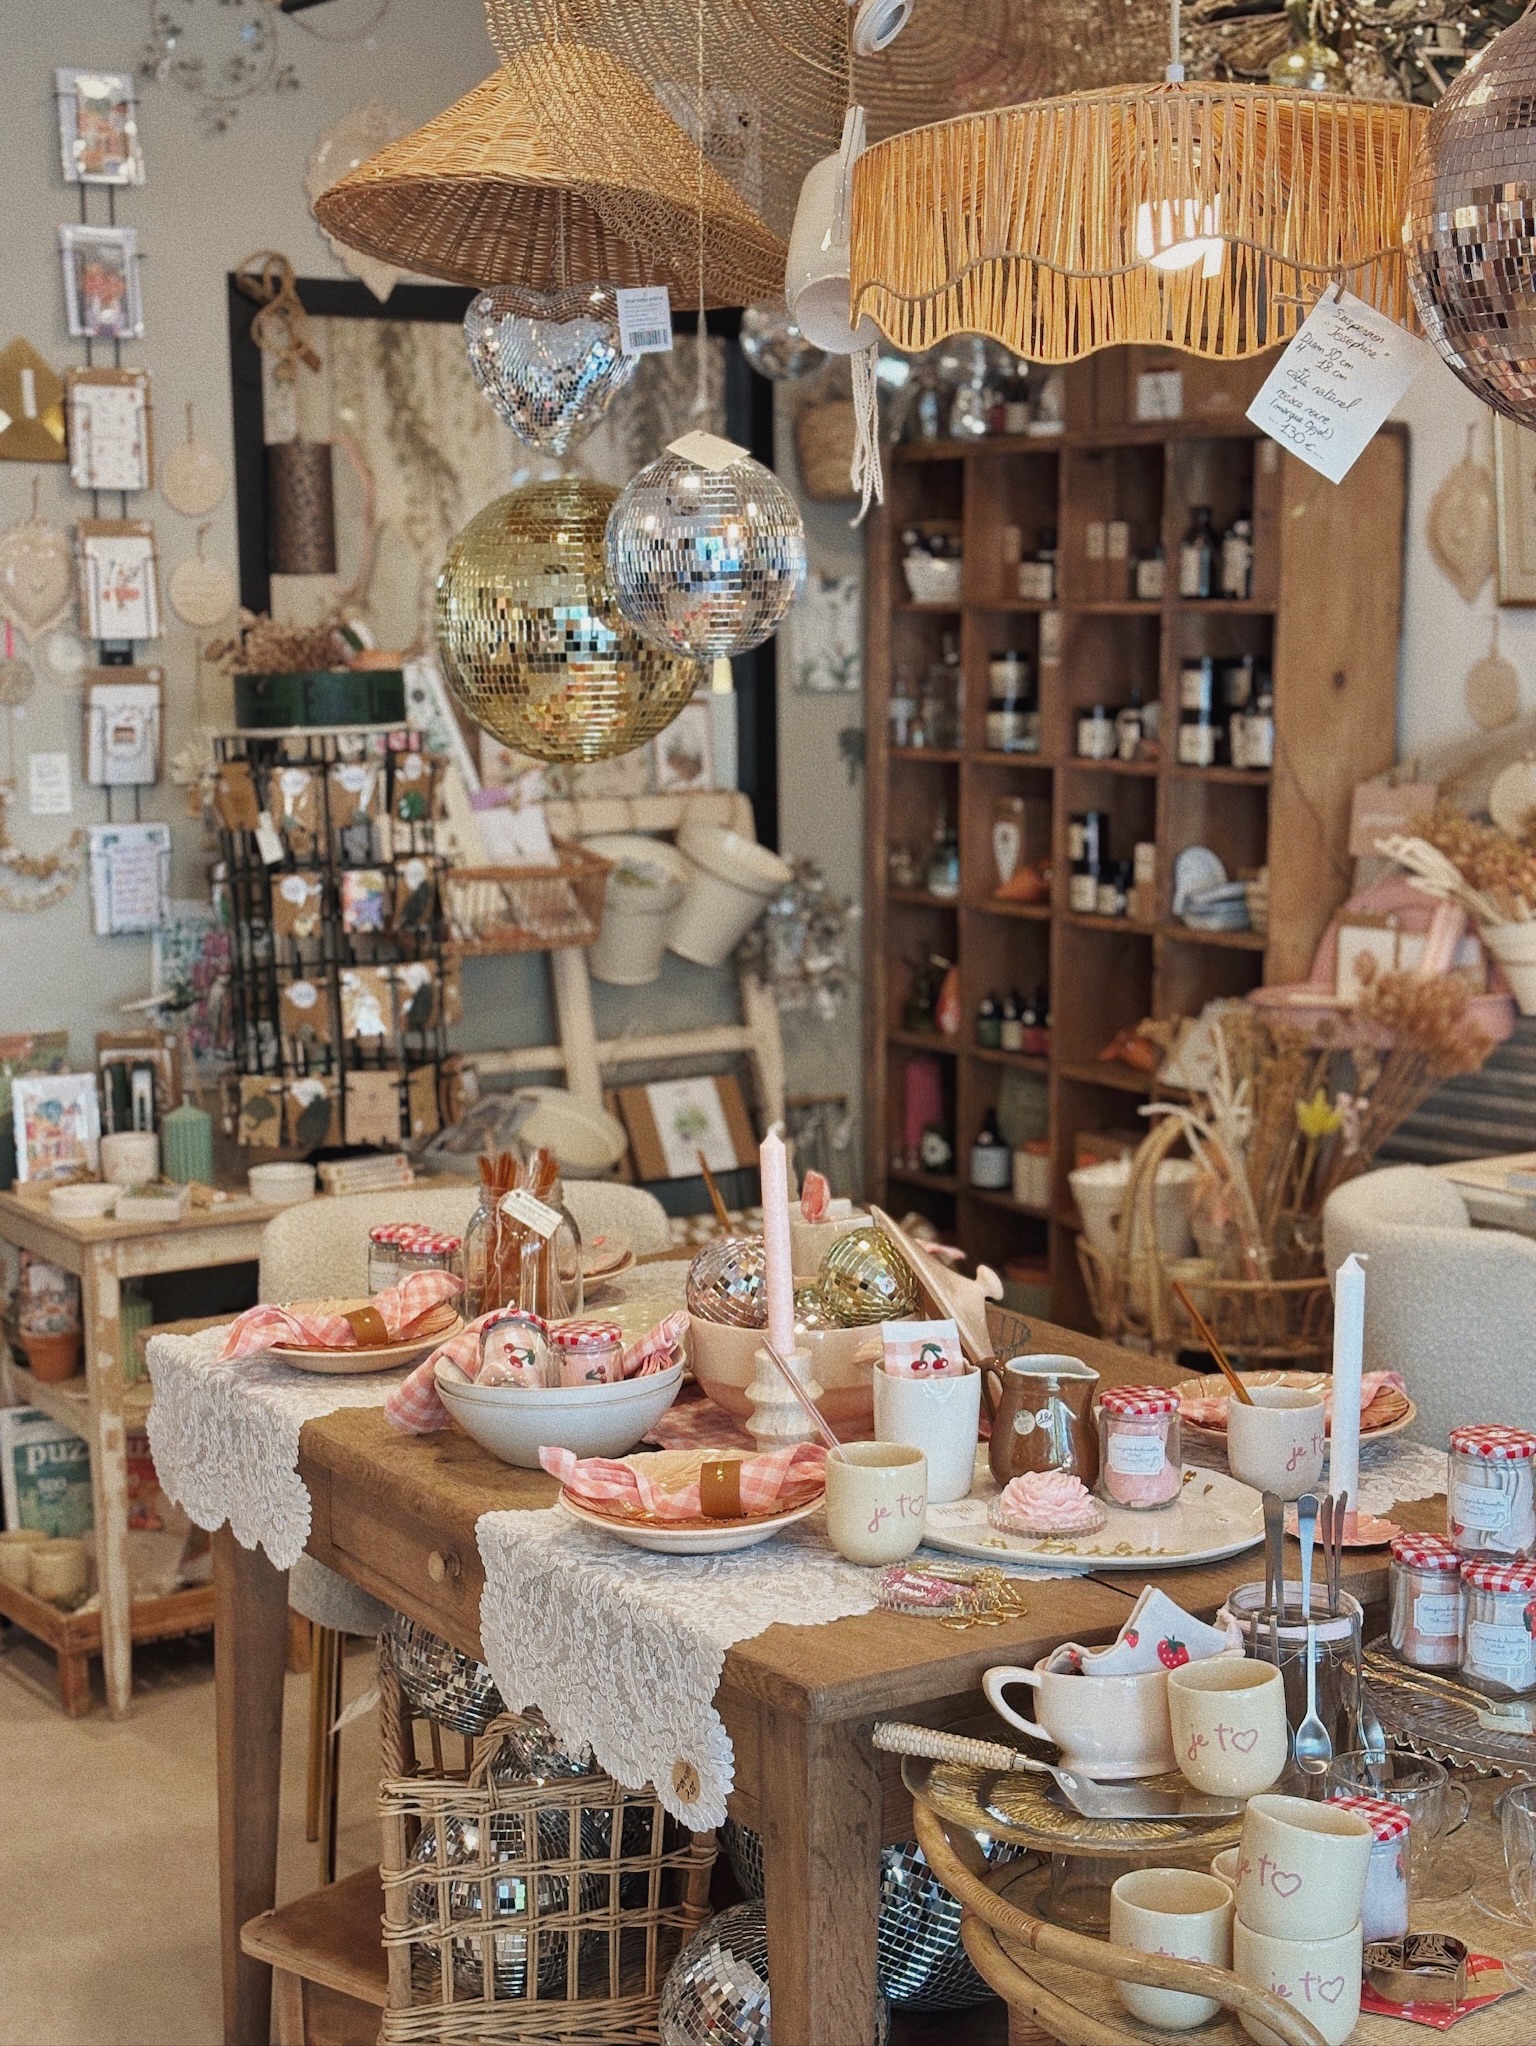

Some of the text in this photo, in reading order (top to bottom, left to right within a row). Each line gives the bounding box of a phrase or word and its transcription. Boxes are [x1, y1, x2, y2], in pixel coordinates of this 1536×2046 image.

[1332, 308, 1385, 344] Suspension
[1316, 358, 1332, 373] 18
[1332, 369, 1348, 381] cm
[1339, 358, 1354, 370] cm
[1286, 1438, 1307, 1472] je
[867, 1499, 892, 1533] je
[1188, 1723, 1209, 1761] je
